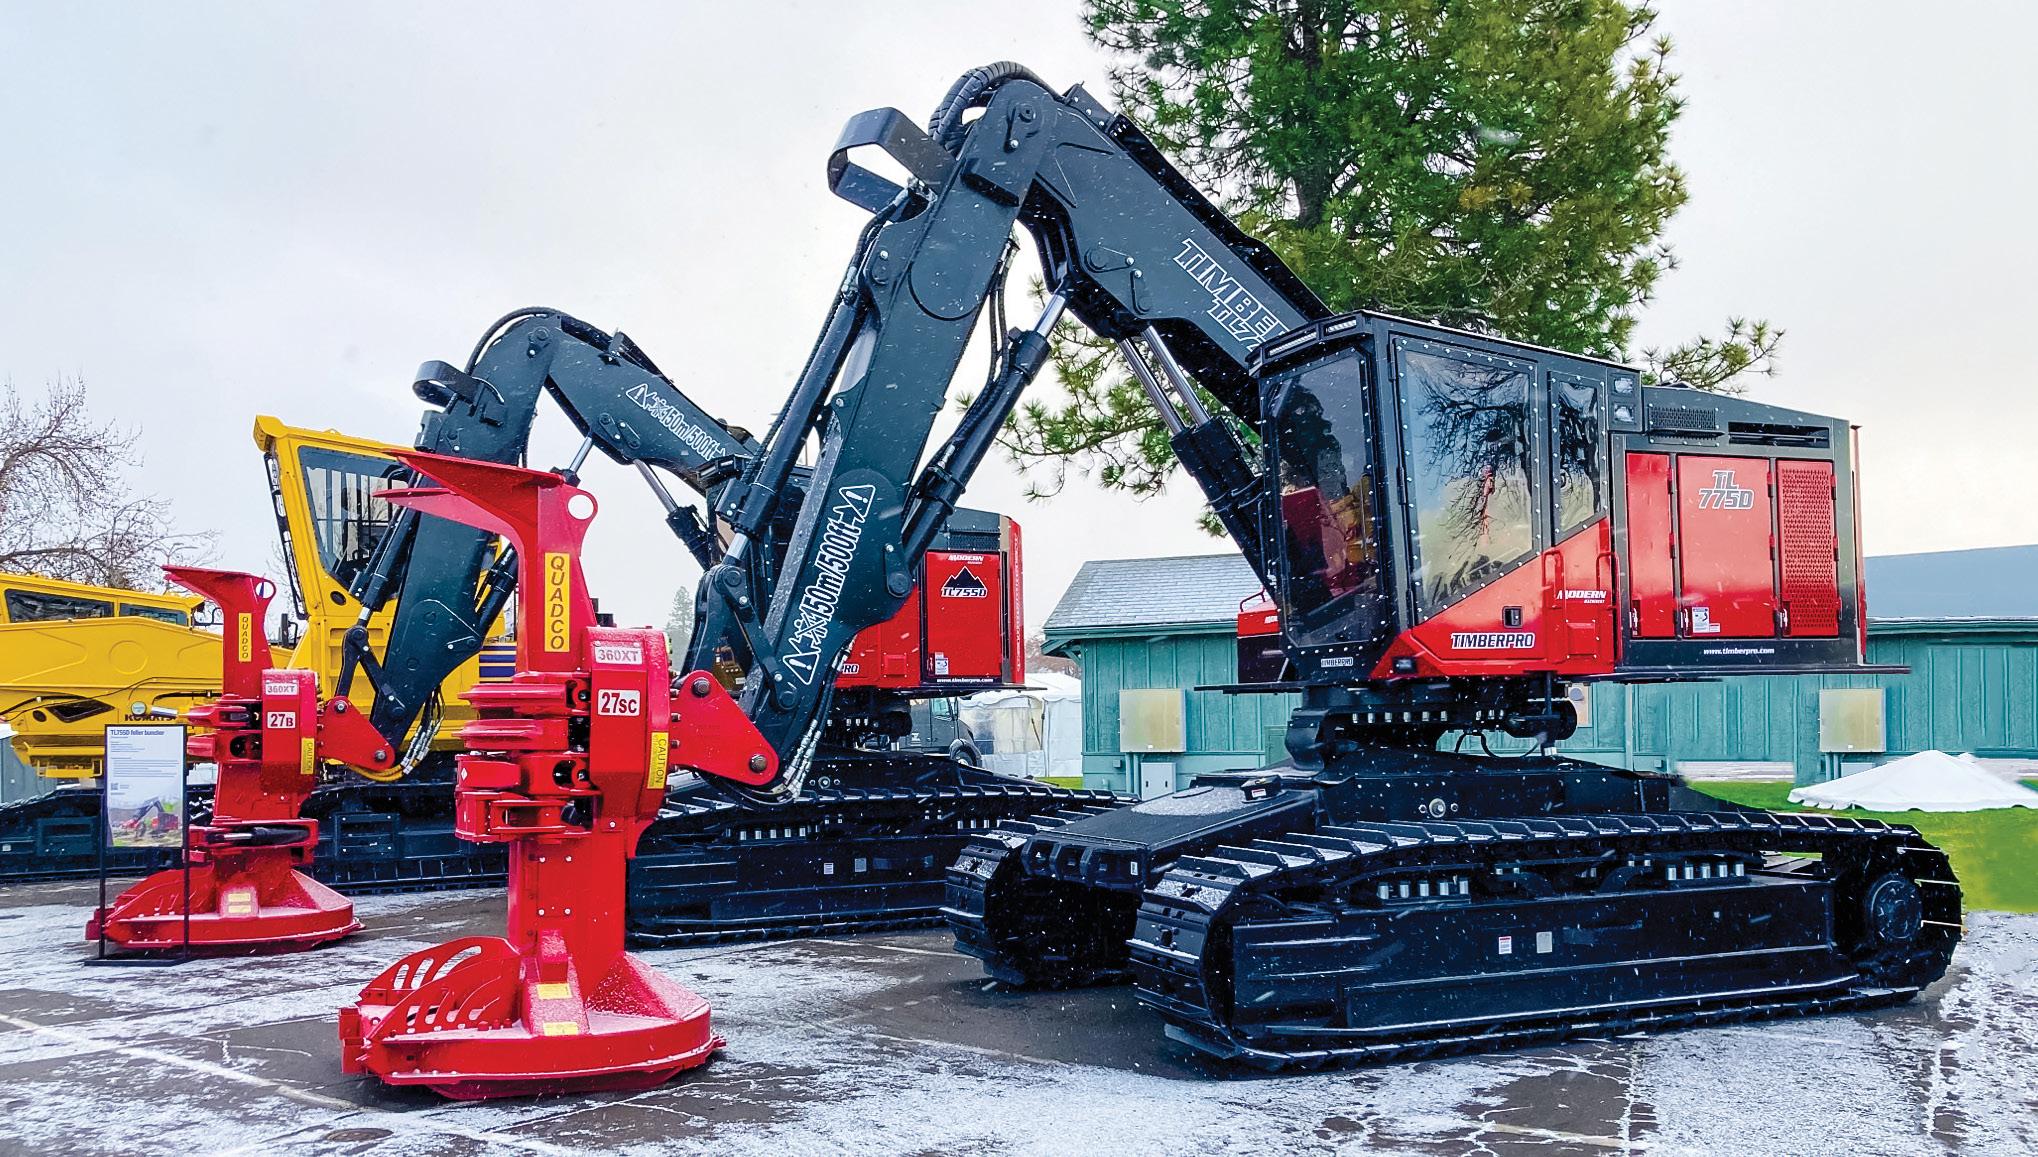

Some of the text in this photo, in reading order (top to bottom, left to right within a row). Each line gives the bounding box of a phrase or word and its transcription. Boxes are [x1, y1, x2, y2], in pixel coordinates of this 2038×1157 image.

[1713, 470, 1739, 489] TL
[1699, 489, 1754, 509] 775D
[942, 587, 988, 597] TL755D
[1557, 590, 1606, 599] MODERN
[550, 555, 565, 650] QUADCO
[241, 616, 249, 659] QUADCO
[1450, 632, 1536, 649] TIMBERPRO
[598, 649, 638, 662] 360XT
[1703, 647, 1774, 656] www.timberpro.com
[267, 683, 296, 693] 360XT
[601, 692, 637, 714] 27SC
[270, 713, 293, 727] 27B
[656, 739, 666, 783] CAUTION
